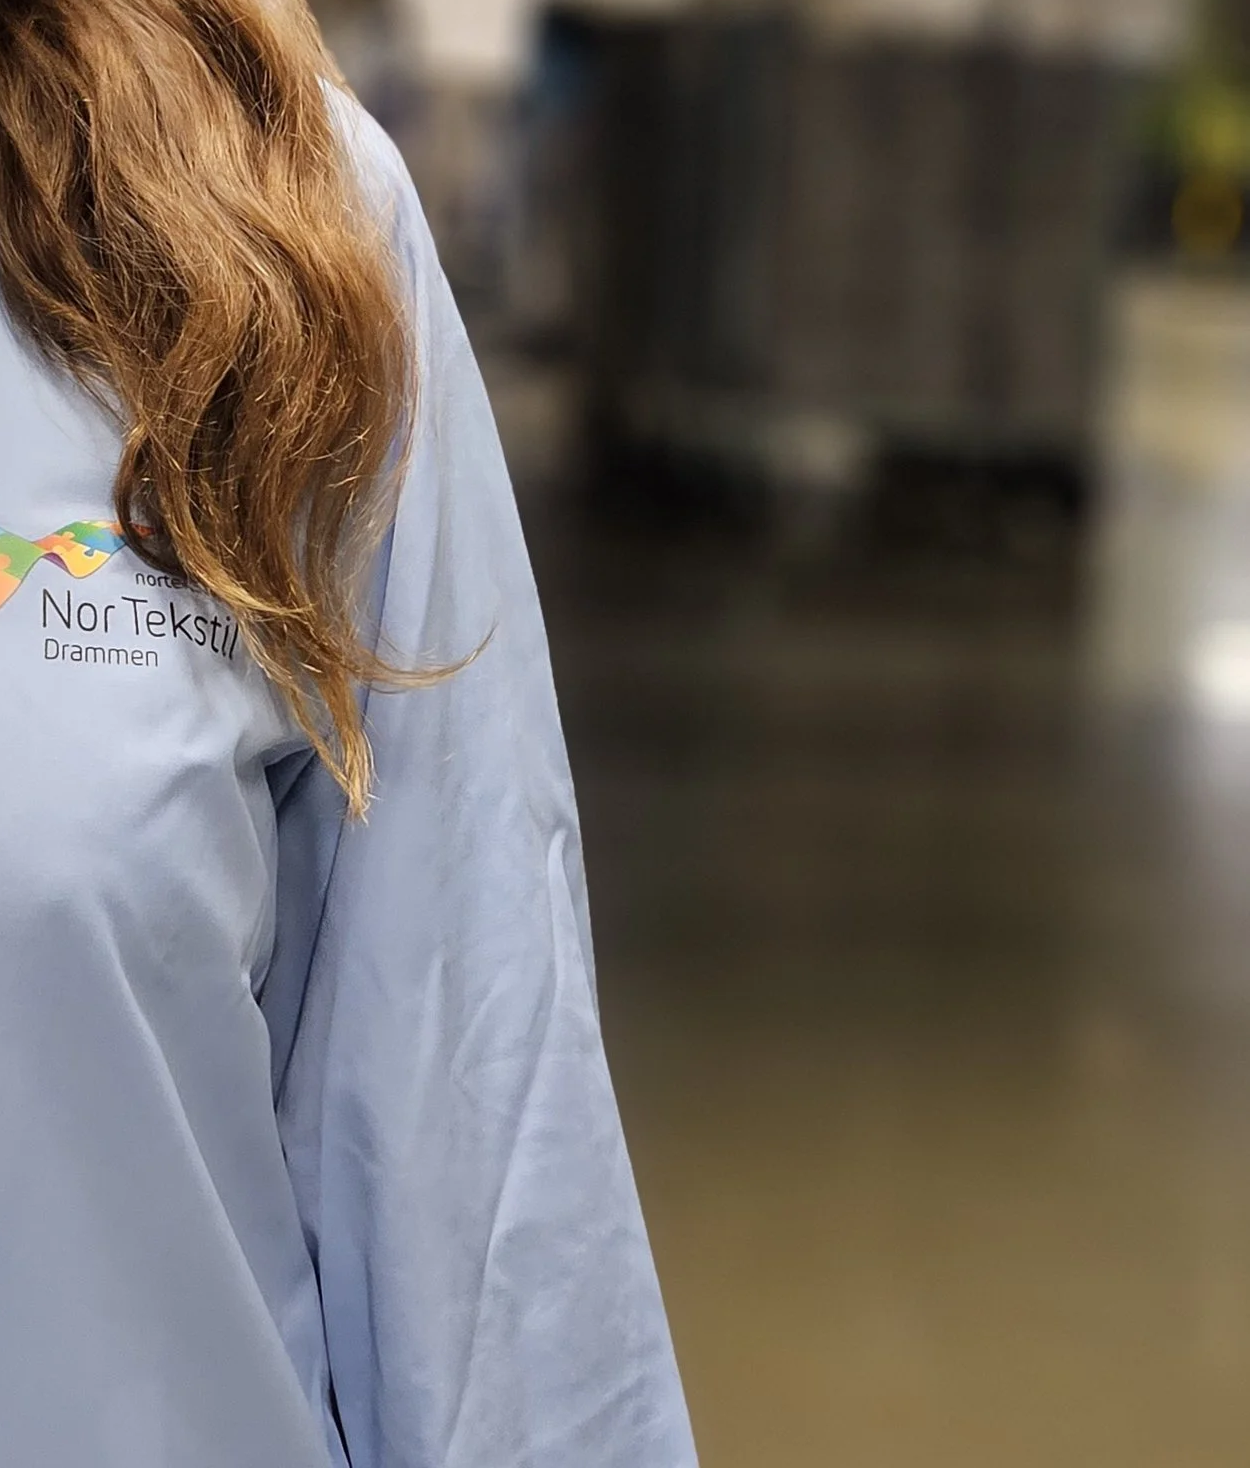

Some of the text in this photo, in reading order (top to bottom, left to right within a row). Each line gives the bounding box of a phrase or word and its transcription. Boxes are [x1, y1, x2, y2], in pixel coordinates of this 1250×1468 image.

[135, 572, 189, 589] norte
[41, 588, 239, 660] Nor Tekstil
[44, 638, 158, 667] Drammen
